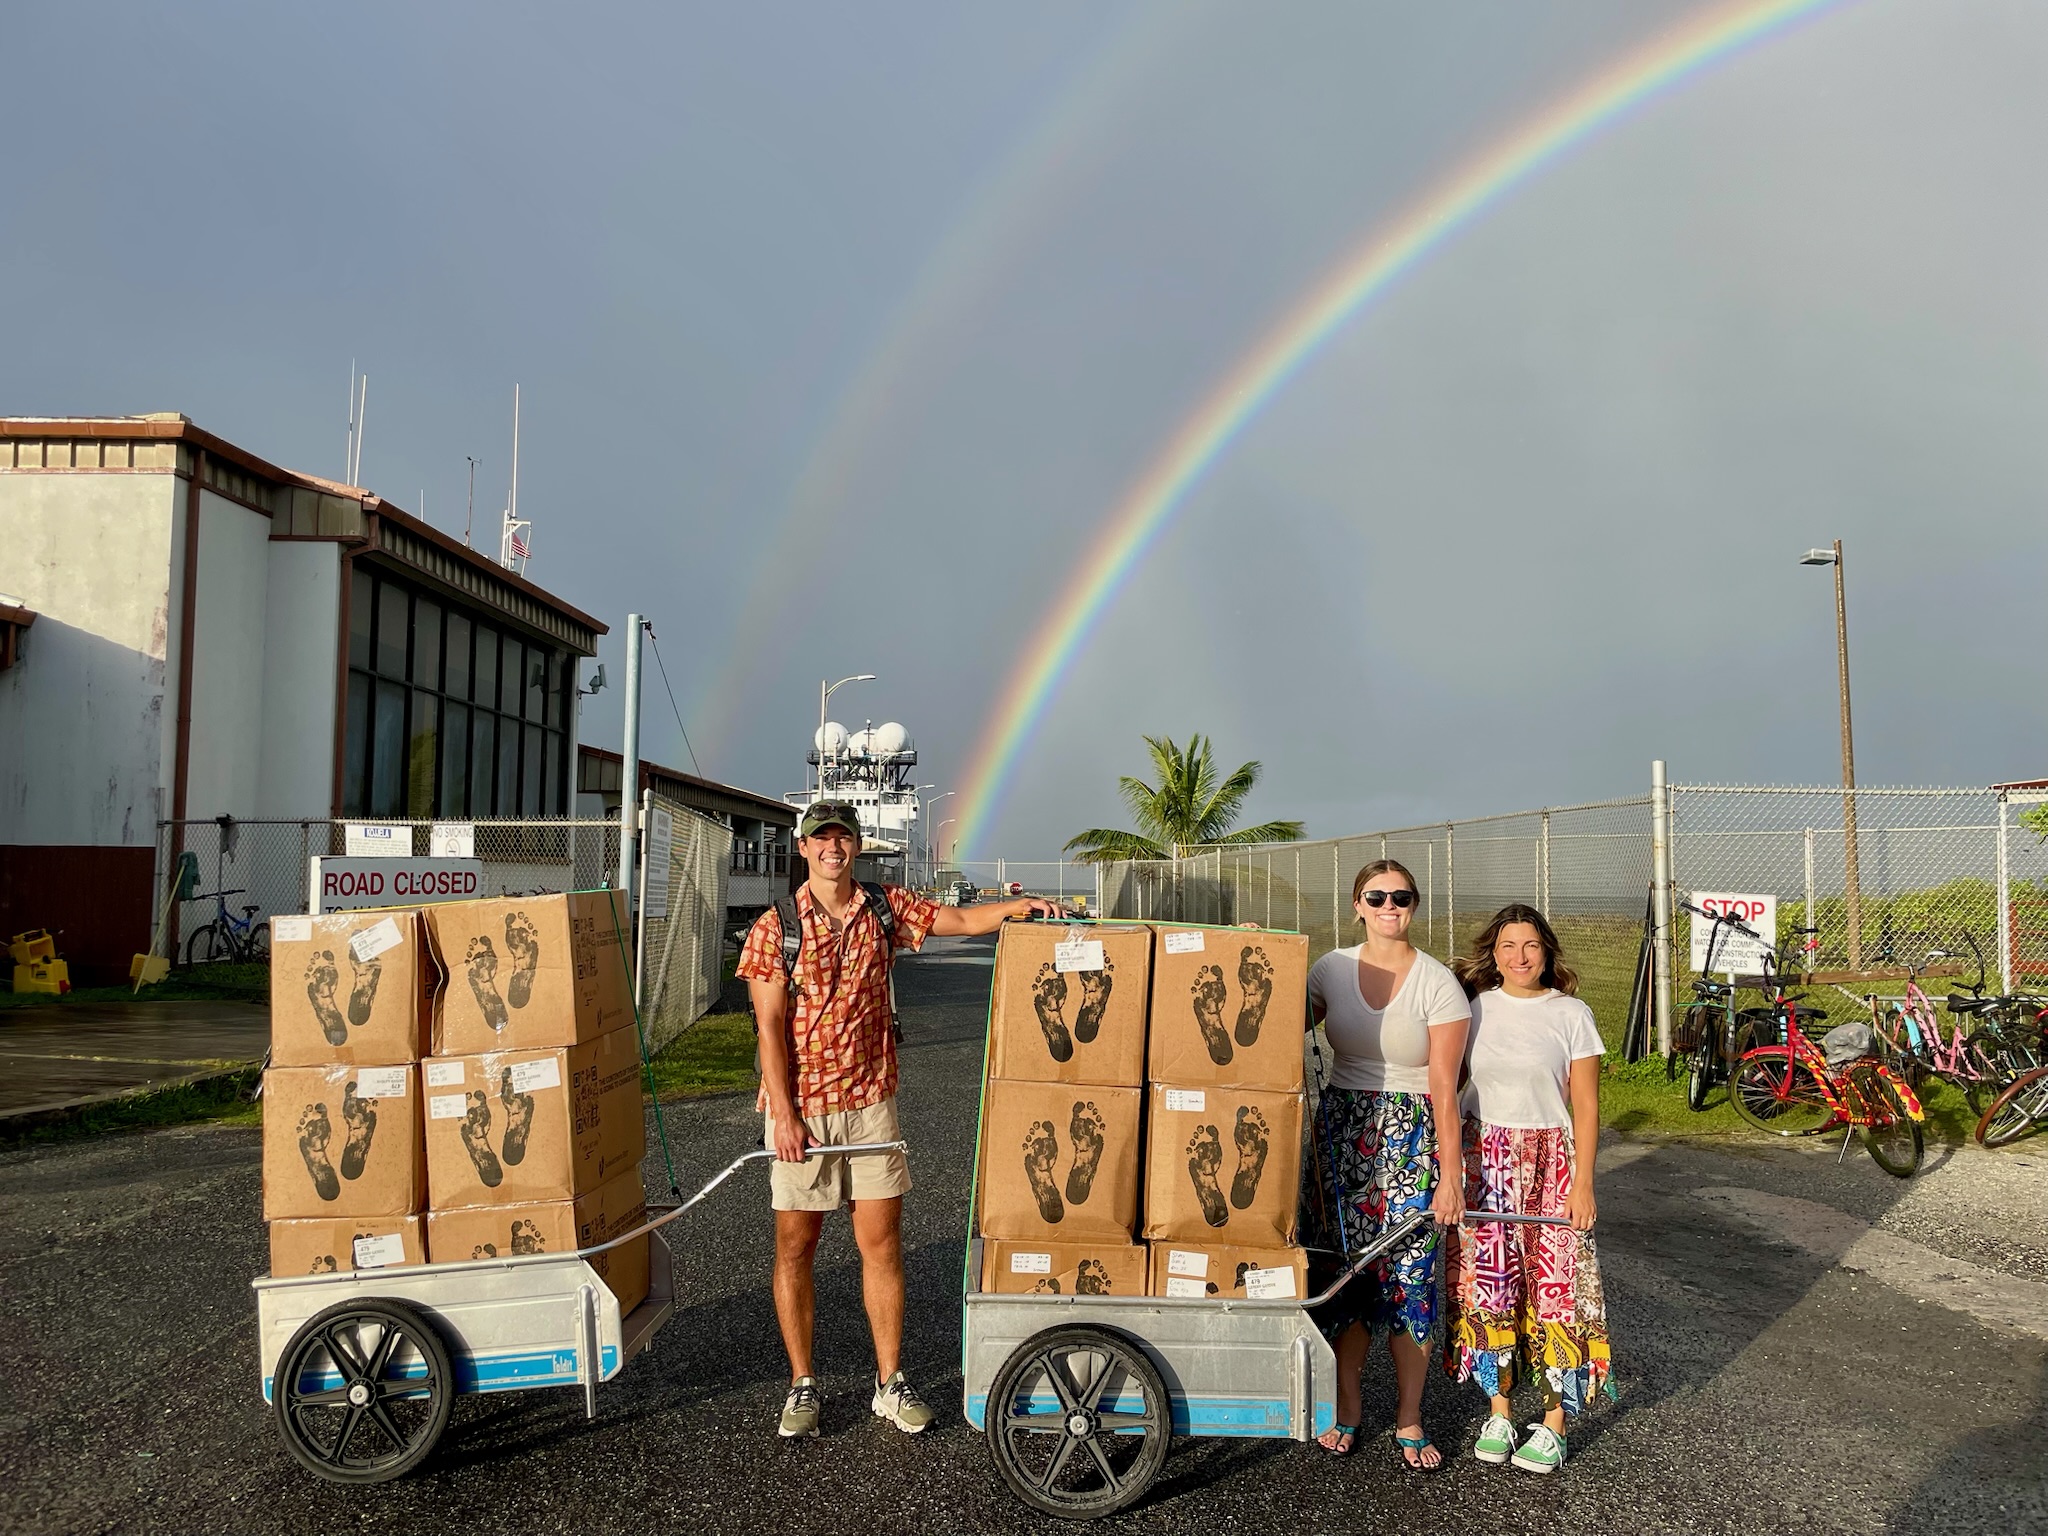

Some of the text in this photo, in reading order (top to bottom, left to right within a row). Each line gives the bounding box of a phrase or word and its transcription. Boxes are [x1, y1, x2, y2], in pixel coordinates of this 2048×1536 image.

[434, 827, 473, 838] NO SMOKING
[324, 871, 477, 896] ROAD CLOSED
[1702, 898, 1765, 922] STOP
[1717, 939, 1730, 947] FOR
[1717, 958, 1748, 968] VEHICLES
